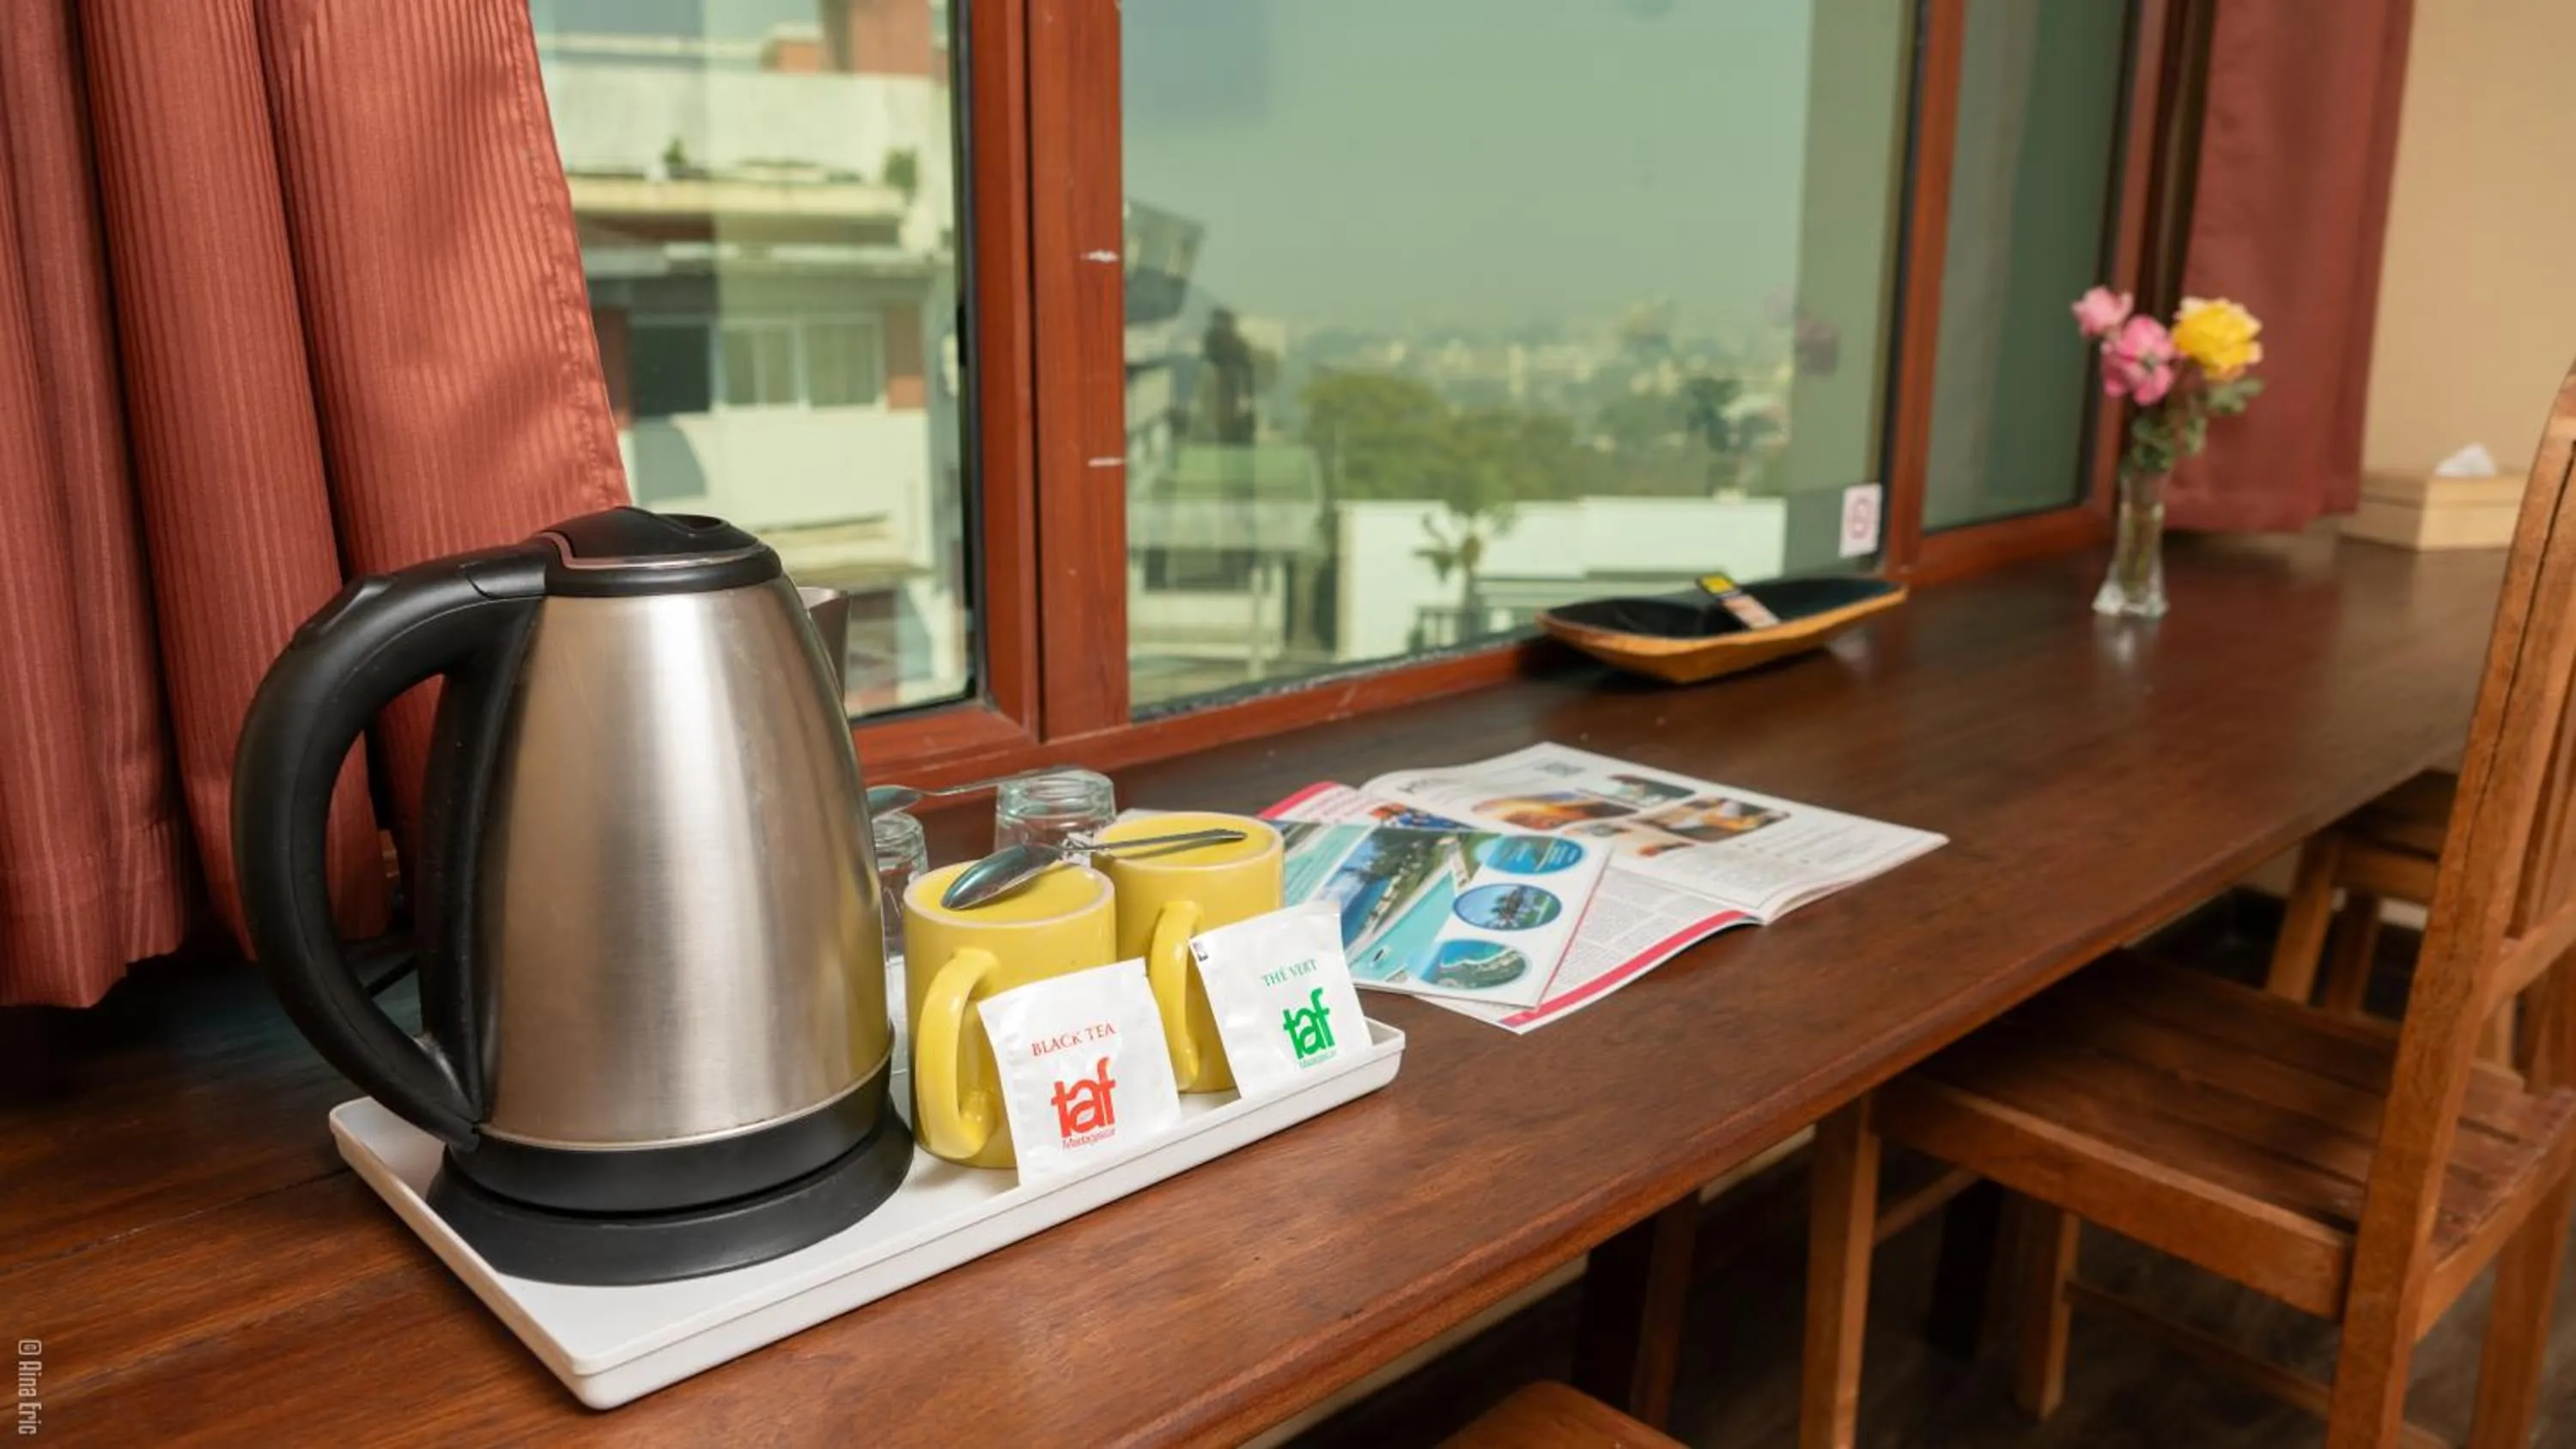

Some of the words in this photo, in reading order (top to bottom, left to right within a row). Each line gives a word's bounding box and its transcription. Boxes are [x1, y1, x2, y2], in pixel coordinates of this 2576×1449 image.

[1031, 1032, 1082, 1057] BLACK
[1085, 1022, 1116, 1040] TEA
[1283, 987, 1335, 1060] taf
[1051, 1057, 1116, 1138] taf
